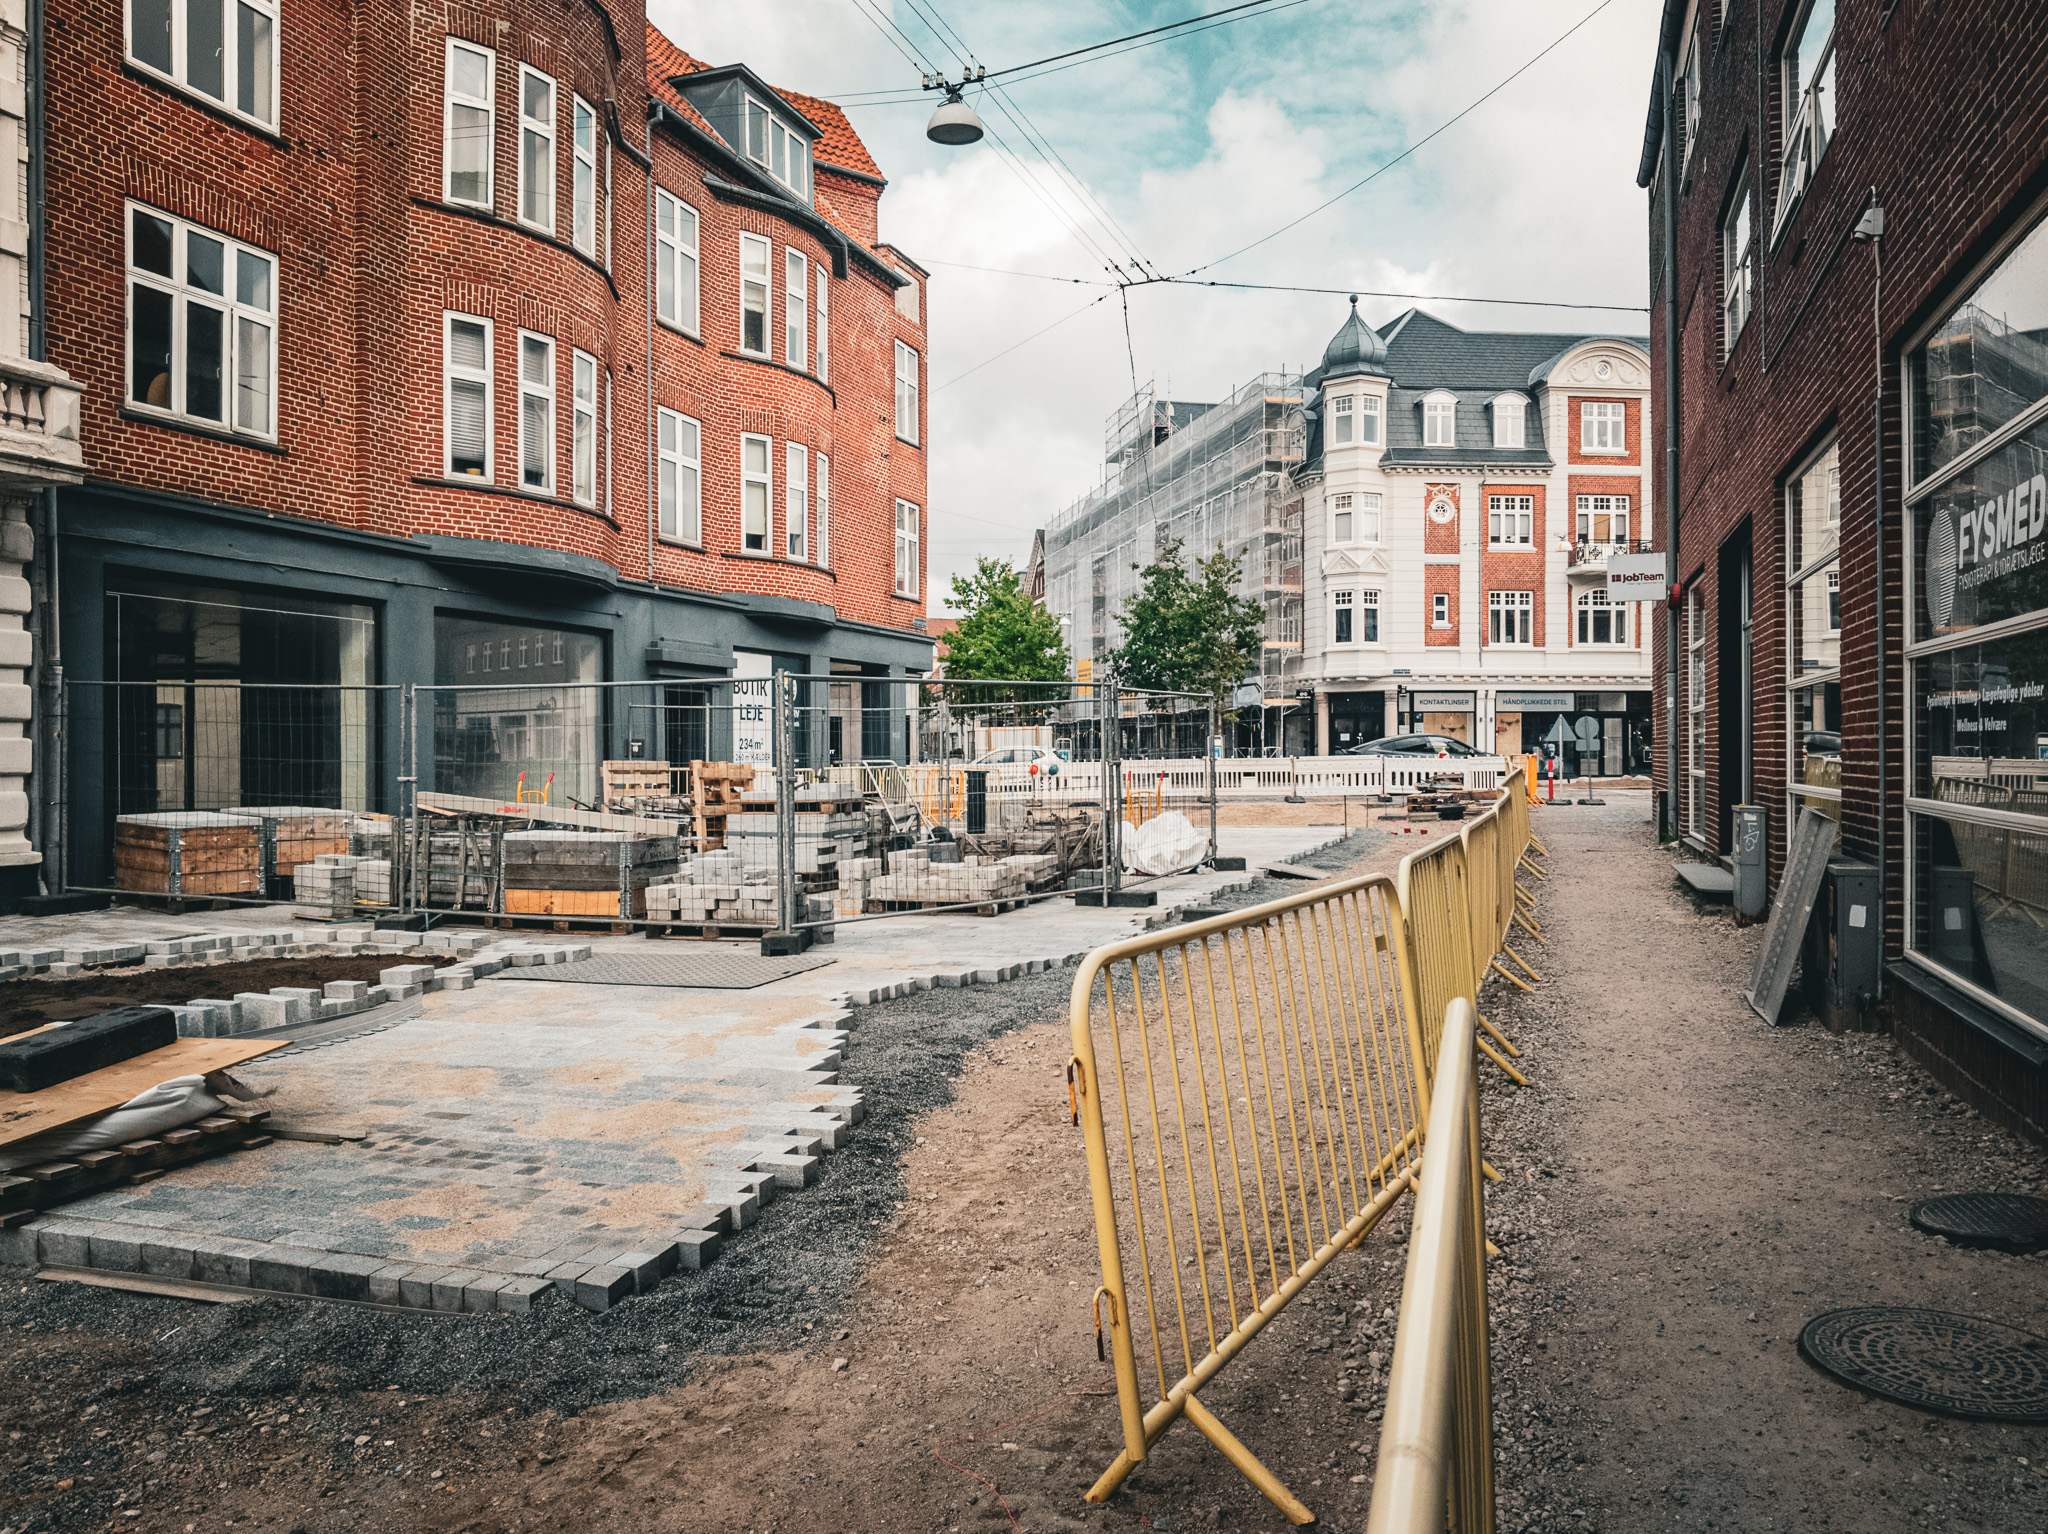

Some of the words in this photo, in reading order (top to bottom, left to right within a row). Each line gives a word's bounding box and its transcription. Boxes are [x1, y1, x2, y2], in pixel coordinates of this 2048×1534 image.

[1959, 473, 2046, 569] FYSMED
[1959, 563, 1993, 591] FYSIOTERAPI
[1994, 561, 1999, 578] &
[2000, 542, 2045, 575] IDRÆTSLÆGE
[1622, 573, 1664, 583] JobTeam
[733, 680, 768, 696] BUTIK
[1982, 684, 2018, 704] Lægefaglige
[2019, 681, 2044, 702] ydelser
[1502, 697, 1552, 705] HÅNDPLUKKEDE
[740, 704, 764, 721] LEJE
[1956, 718, 1978, 732] Wellness
[1984, 716, 2007, 731] Velvære
[739, 738, 753, 749] 234
